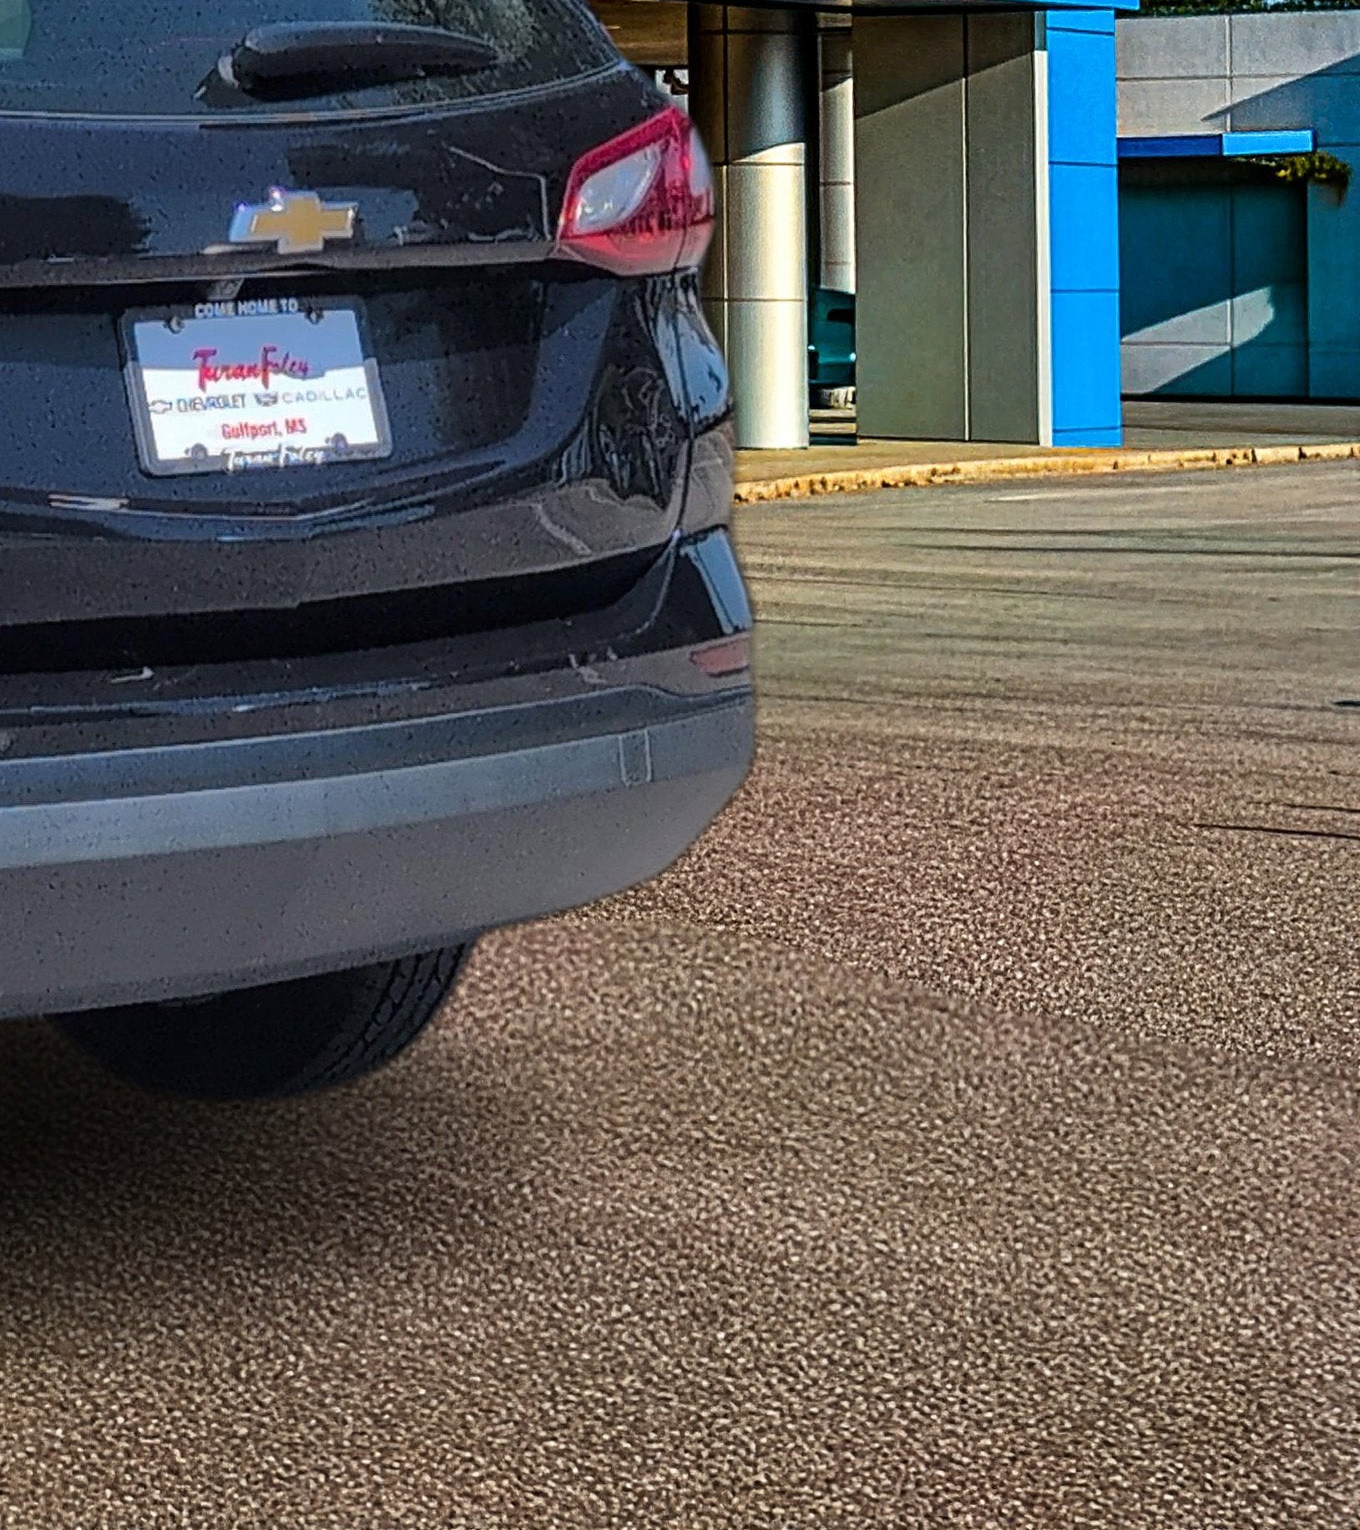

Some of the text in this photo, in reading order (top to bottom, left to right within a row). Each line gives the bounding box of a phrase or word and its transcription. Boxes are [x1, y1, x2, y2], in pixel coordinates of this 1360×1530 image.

[194, 297, 299, 318] COME HOME TO
[282, 387, 367, 404] CADILLAC
